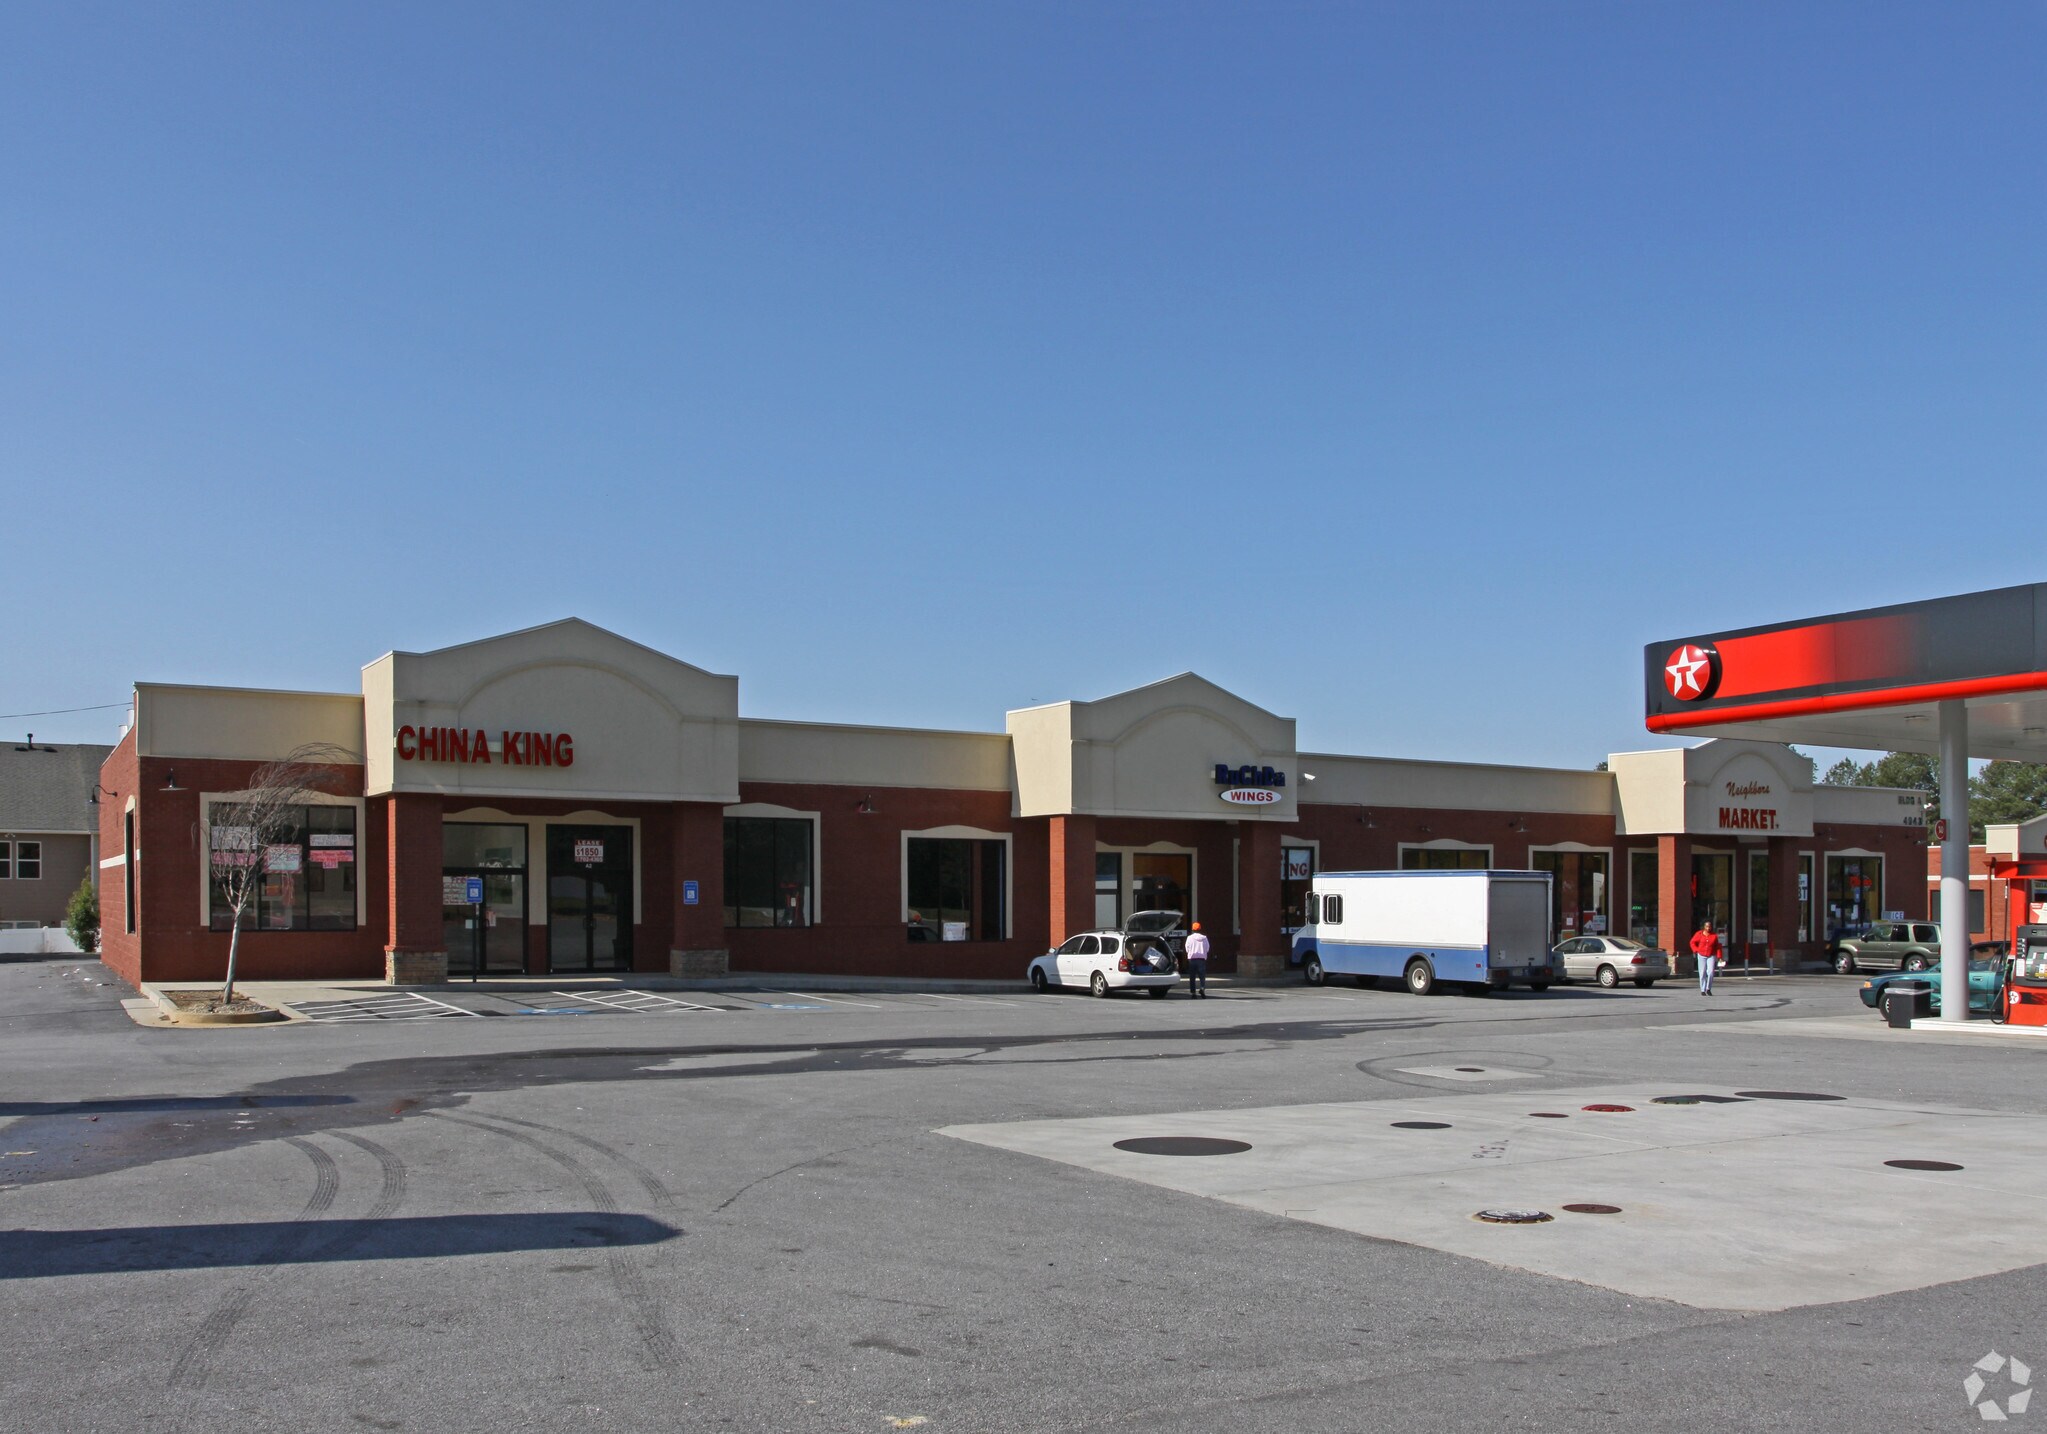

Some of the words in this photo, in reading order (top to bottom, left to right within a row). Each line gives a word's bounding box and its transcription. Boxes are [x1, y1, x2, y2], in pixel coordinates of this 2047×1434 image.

[397, 725, 492, 764] CHINA
[502, 731, 574, 767] KING
[1230, 791, 1274, 802] WINGS
[1726, 780, 1770, 800] Neighbors
[576, 847, 599, 856] $1850
